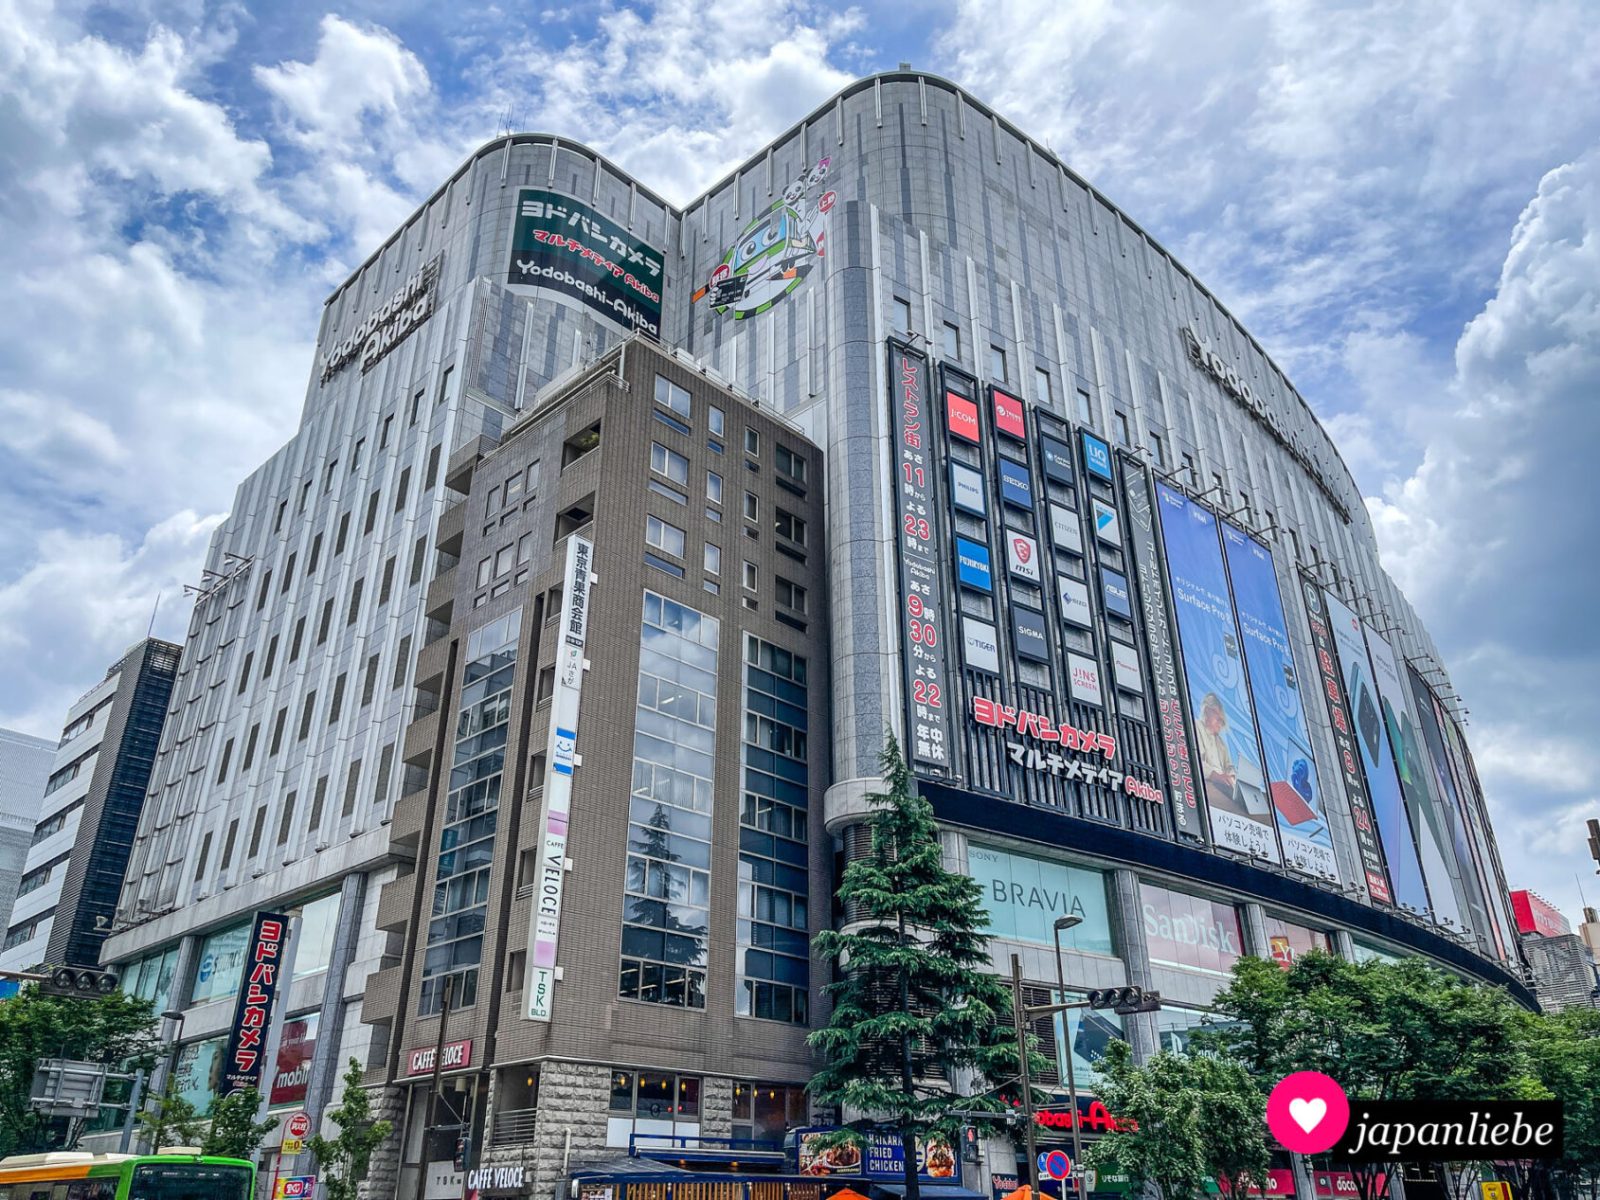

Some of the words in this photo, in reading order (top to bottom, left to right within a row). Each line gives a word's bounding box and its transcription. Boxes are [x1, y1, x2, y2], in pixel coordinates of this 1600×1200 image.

[521, 200, 661, 277] ヨドバシカメラ
[533, 229, 624, 278] マルチメディア
[624, 273, 660, 303] Akiba
[516, 259, 657, 335] Yodobashi-Akiba
[320, 262, 426, 378] Yodobashi
[360, 292, 428, 371] Akiba
[902, 357, 921, 450] レストラン街
[903, 450, 924, 465] あさ
[903, 463, 924, 487] 11
[1003, 474, 1029, 491] SEIKO
[904, 514, 929, 540] 23
[1015, 564, 1034, 576] msi
[910, 580, 930, 595] あさ
[1177, 587, 1211, 612] Surface
[1018, 625, 1044, 641] SIGMA
[1243, 622, 1272, 646] Surface
[975, 639, 995, 653] TIGER
[915, 665, 937, 679] よる
[1072, 667, 1096, 682] JINS
[913, 679, 942, 708] 22
[1073, 678, 1097, 691] SCREEN
[973, 695, 1116, 760] ヨドバシカメラ
[1007, 741, 1123, 792] マルチメディア
[1124, 775, 1164, 805] Akiba
[970, 849, 998, 863] SONY
[541, 855, 562, 915] VELOCE
[992, 879, 1086, 919] BRAVIA
[1143, 903, 1236, 955] SanDisk
[235, 920, 282, 1072] ヨドバシカメラ
[536, 971, 547, 1007] TSK
[869, 1147, 892, 1159] FRIED
[494, 1166, 525, 1189] VELOCE
[869, 1160, 904, 1172] CHICKEN
[1101, 1174, 1130, 1184] りそな銀行
